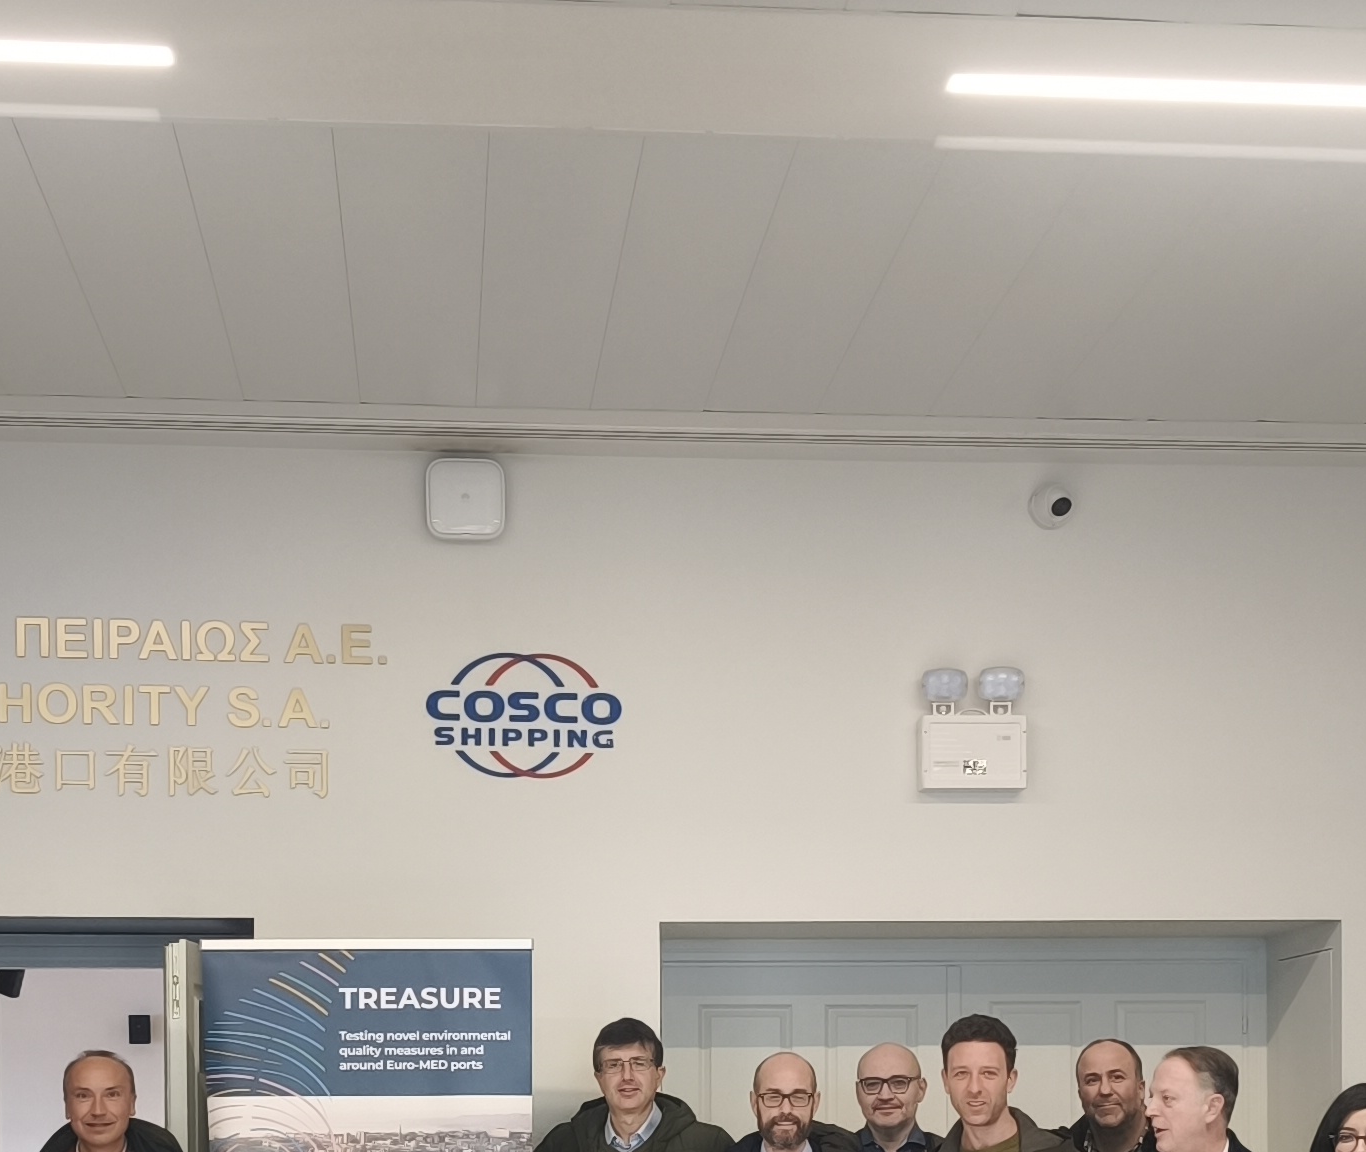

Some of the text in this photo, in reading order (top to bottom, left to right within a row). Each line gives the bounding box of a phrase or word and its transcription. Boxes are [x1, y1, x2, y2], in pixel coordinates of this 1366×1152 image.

[14, 616, 271, 664] ΠΕΙΡΑΙΩΣ
[283, 623, 389, 666] Α.Ε.
[226, 687, 331, 731] S.A.
[424, 688, 623, 726] COSCO
[434, 726, 615, 749] SHIPPING
[339, 987, 502, 1010] TREASURE
[339, 1030, 511, 1043] Testing novel environmental
[339, 1045, 484, 1057] quality measures in and
[339, 1060, 483, 1072] around Euro-MED ports
